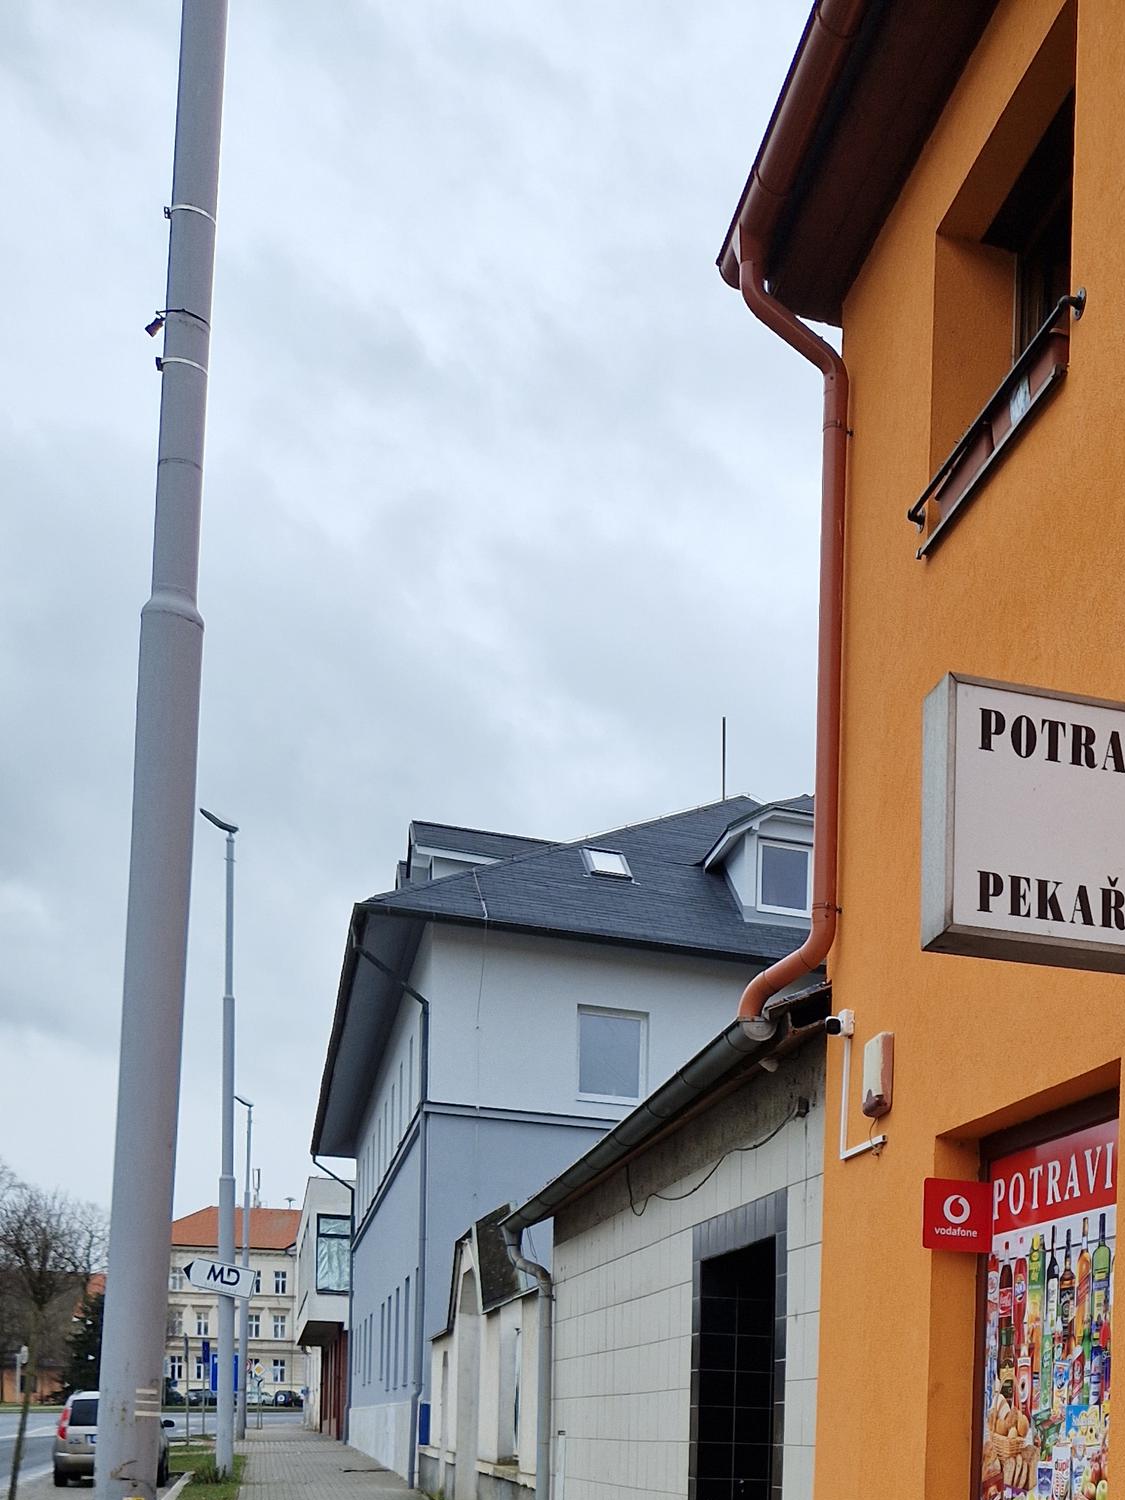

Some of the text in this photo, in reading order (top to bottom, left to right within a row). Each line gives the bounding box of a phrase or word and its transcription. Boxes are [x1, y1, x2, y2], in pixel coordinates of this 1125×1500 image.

[993, 1142, 1114, 1220] POTRAVI
[934, 1226, 978, 1238] vodafone
[206, 1264, 240, 1286] MD
